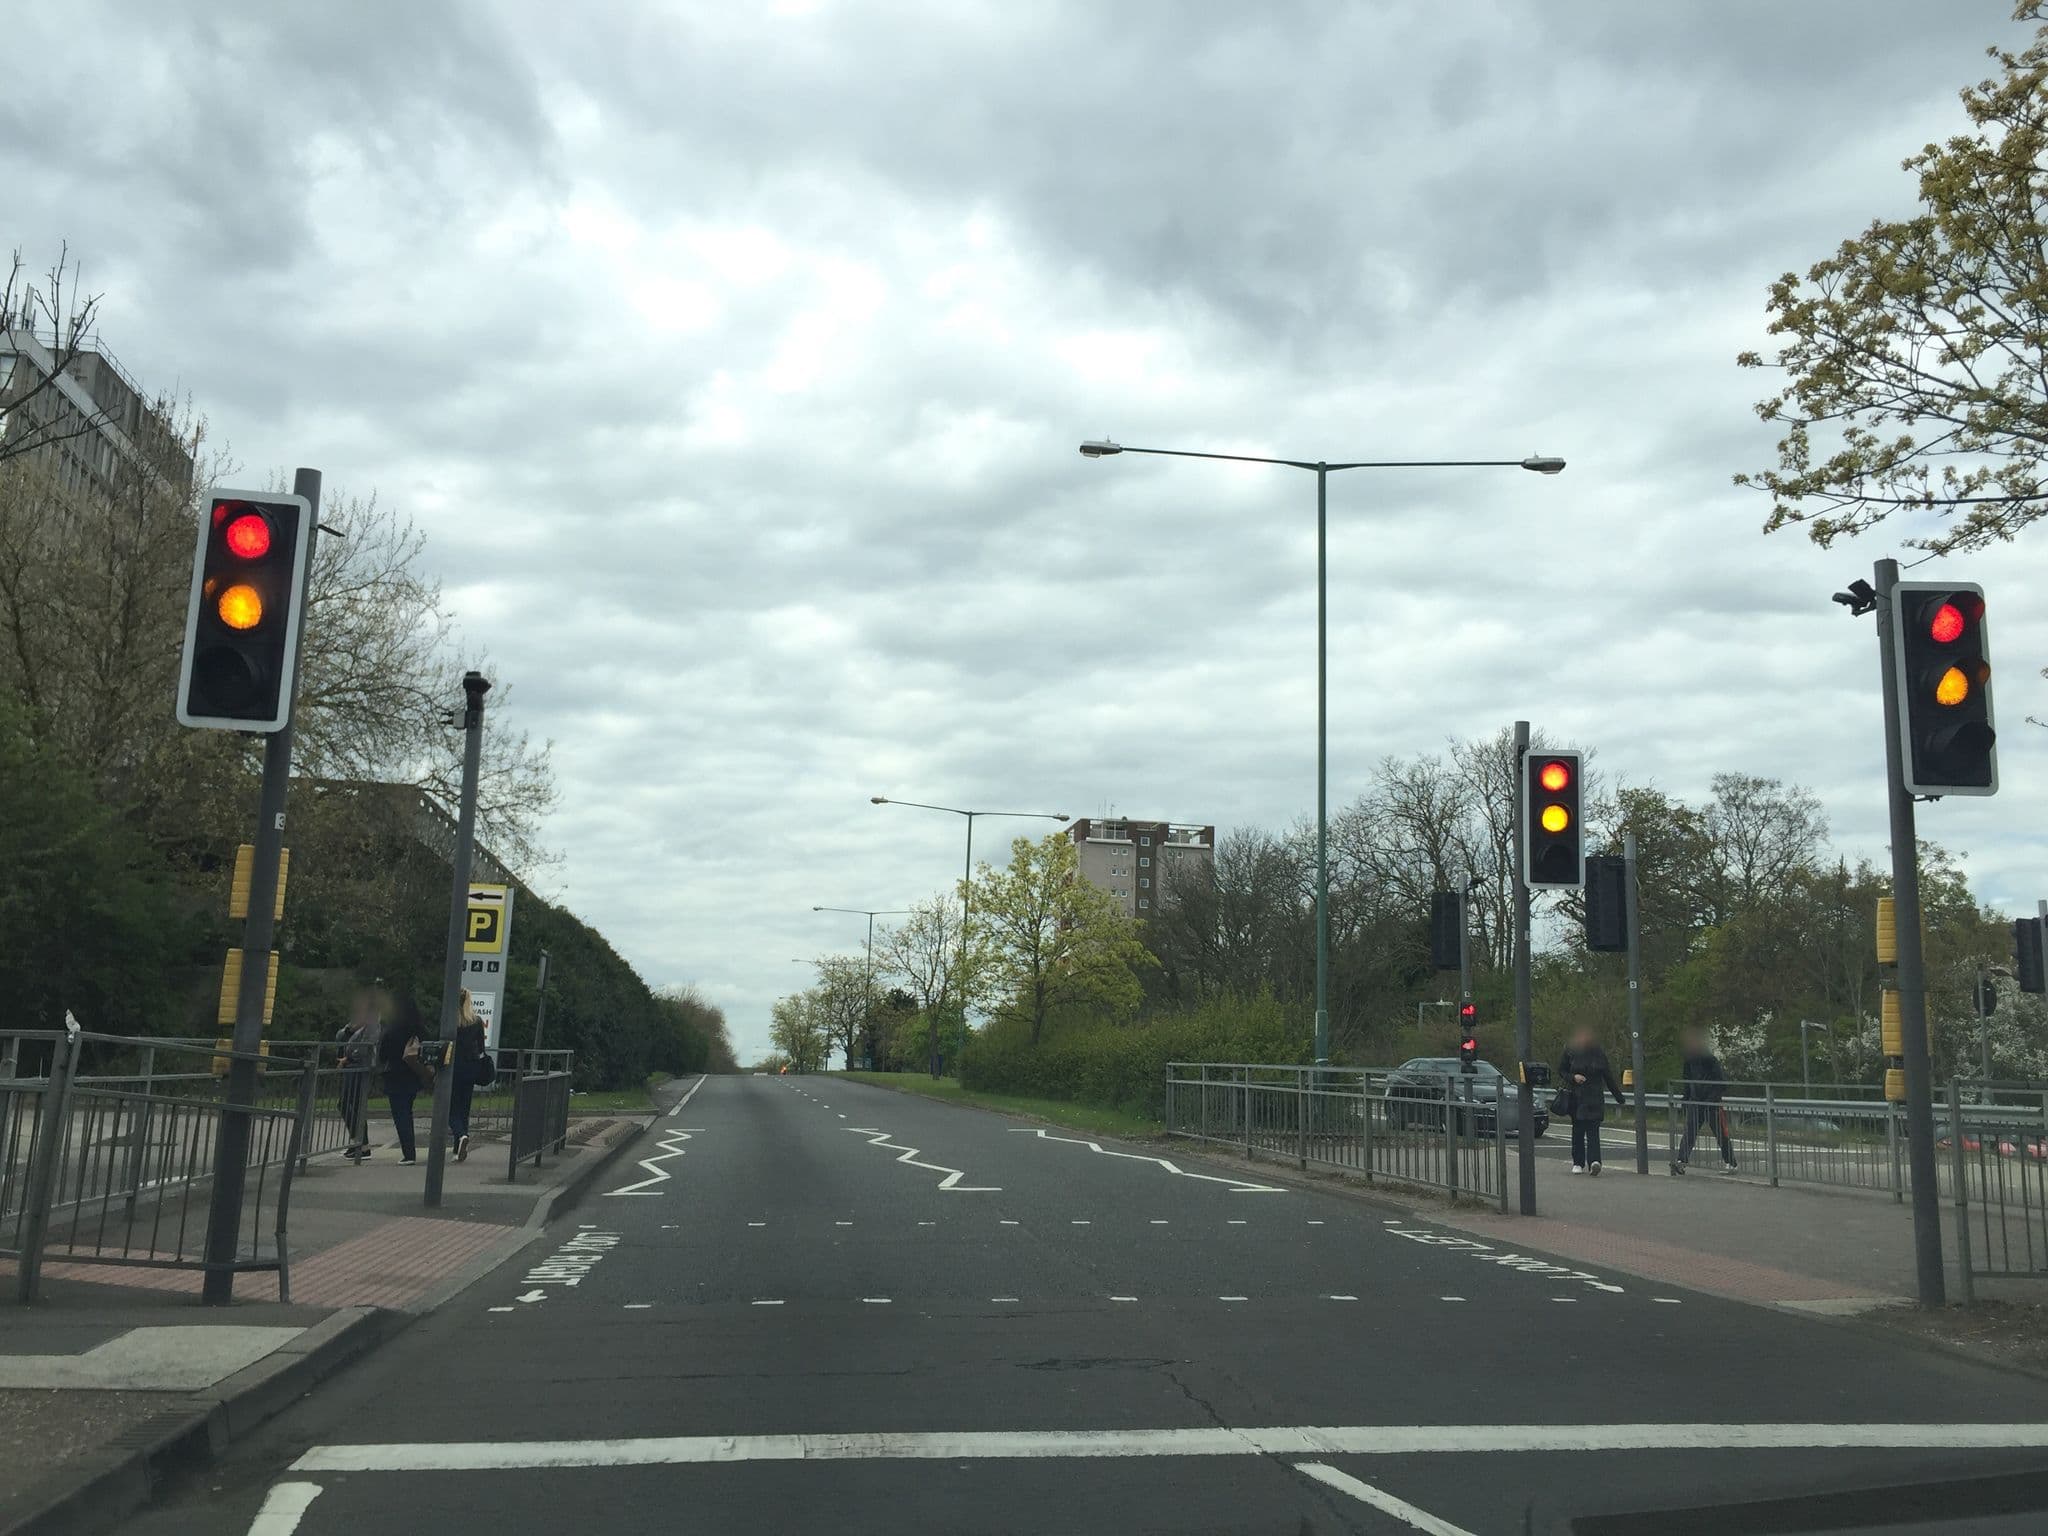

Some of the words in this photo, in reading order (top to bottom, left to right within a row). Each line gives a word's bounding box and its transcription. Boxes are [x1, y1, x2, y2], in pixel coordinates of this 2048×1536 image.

[469, 912, 492, 938] P
[558, 1231, 624, 1252] LOOK
[1384, 1228, 1496, 1250] LEFT
[520, 1255, 604, 1286] RIGHT
[1470, 1253, 1600, 1279] LOOK
